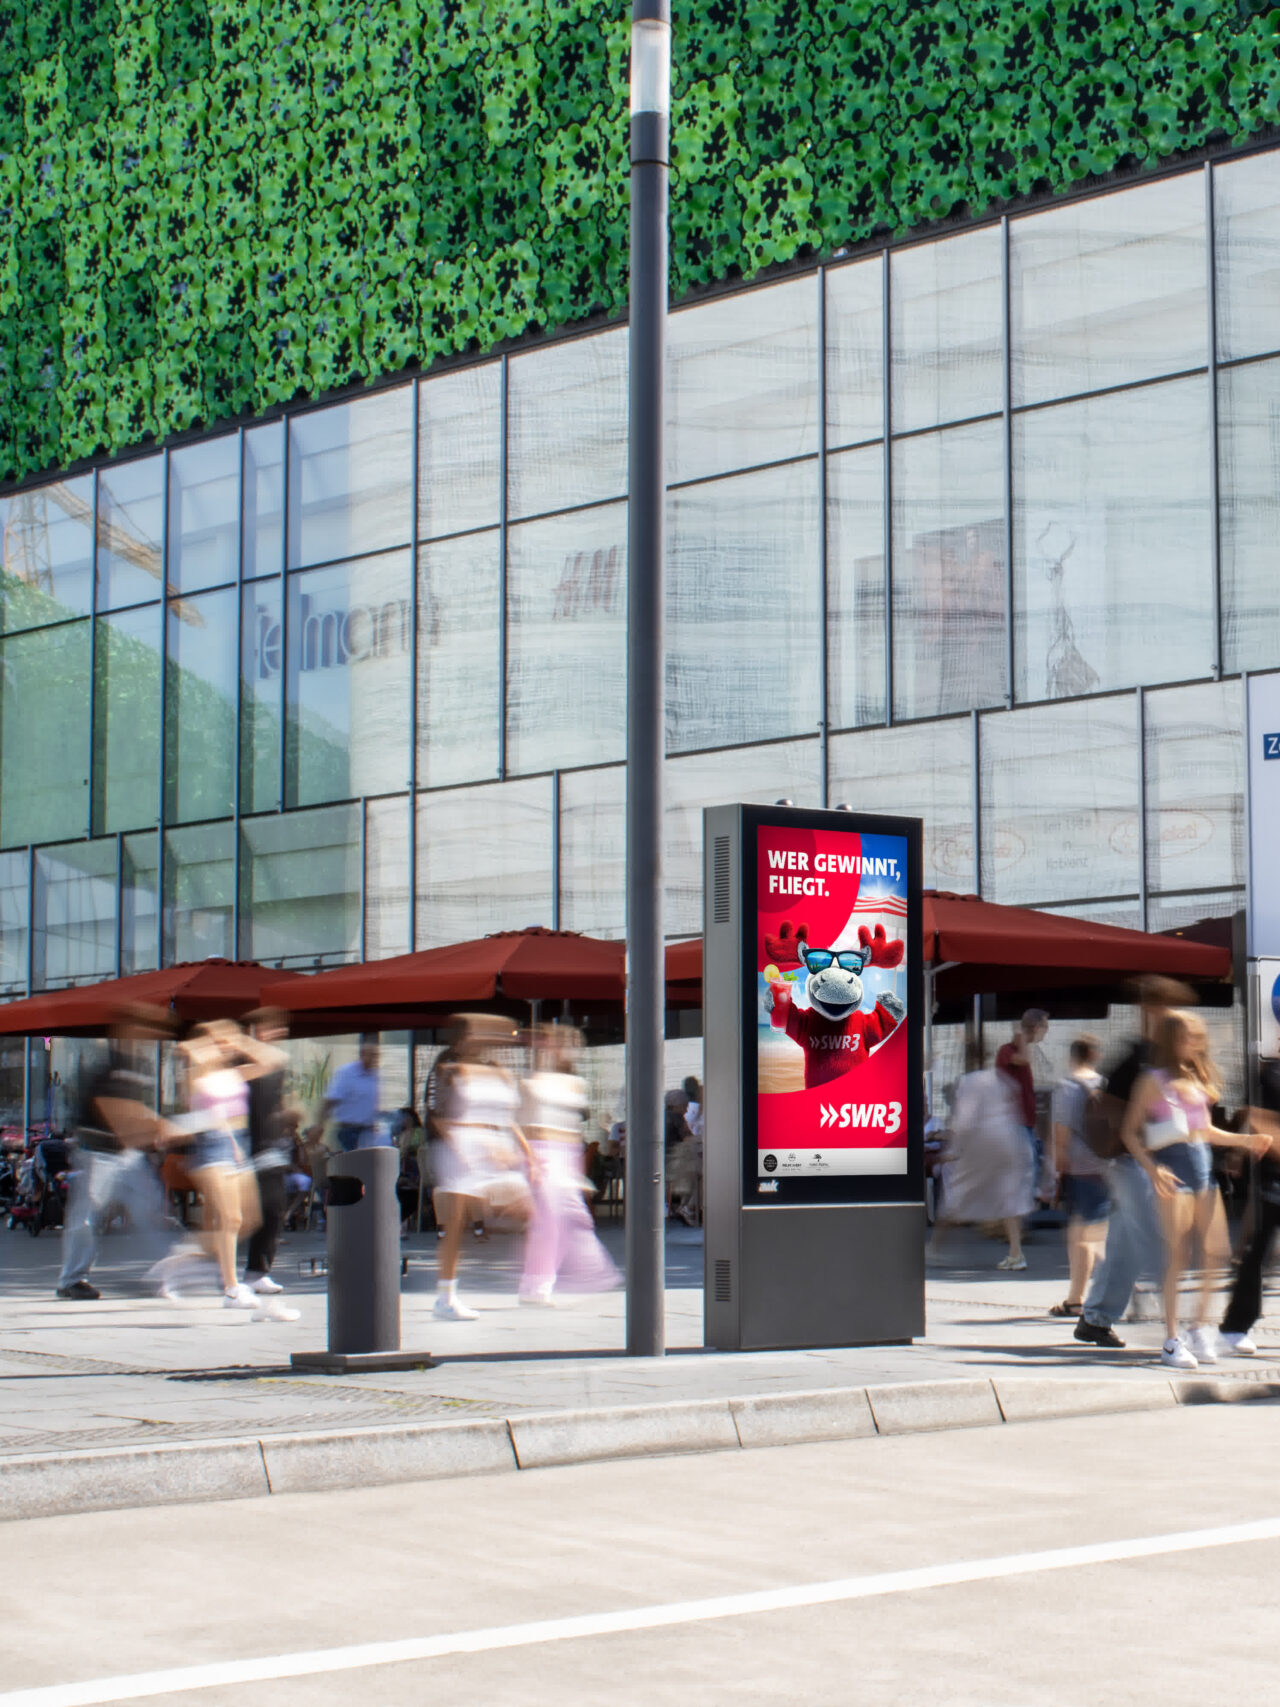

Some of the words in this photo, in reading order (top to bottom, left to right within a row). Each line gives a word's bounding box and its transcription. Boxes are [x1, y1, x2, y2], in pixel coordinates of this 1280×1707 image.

[768, 850, 809, 871] WER
[814, 853, 901, 881] GEWINNT,
[769, 875, 830, 897] FLIEGT.
[820, 1033, 861, 1052] SWR3
[838, 1101, 902, 1134] SWR3
